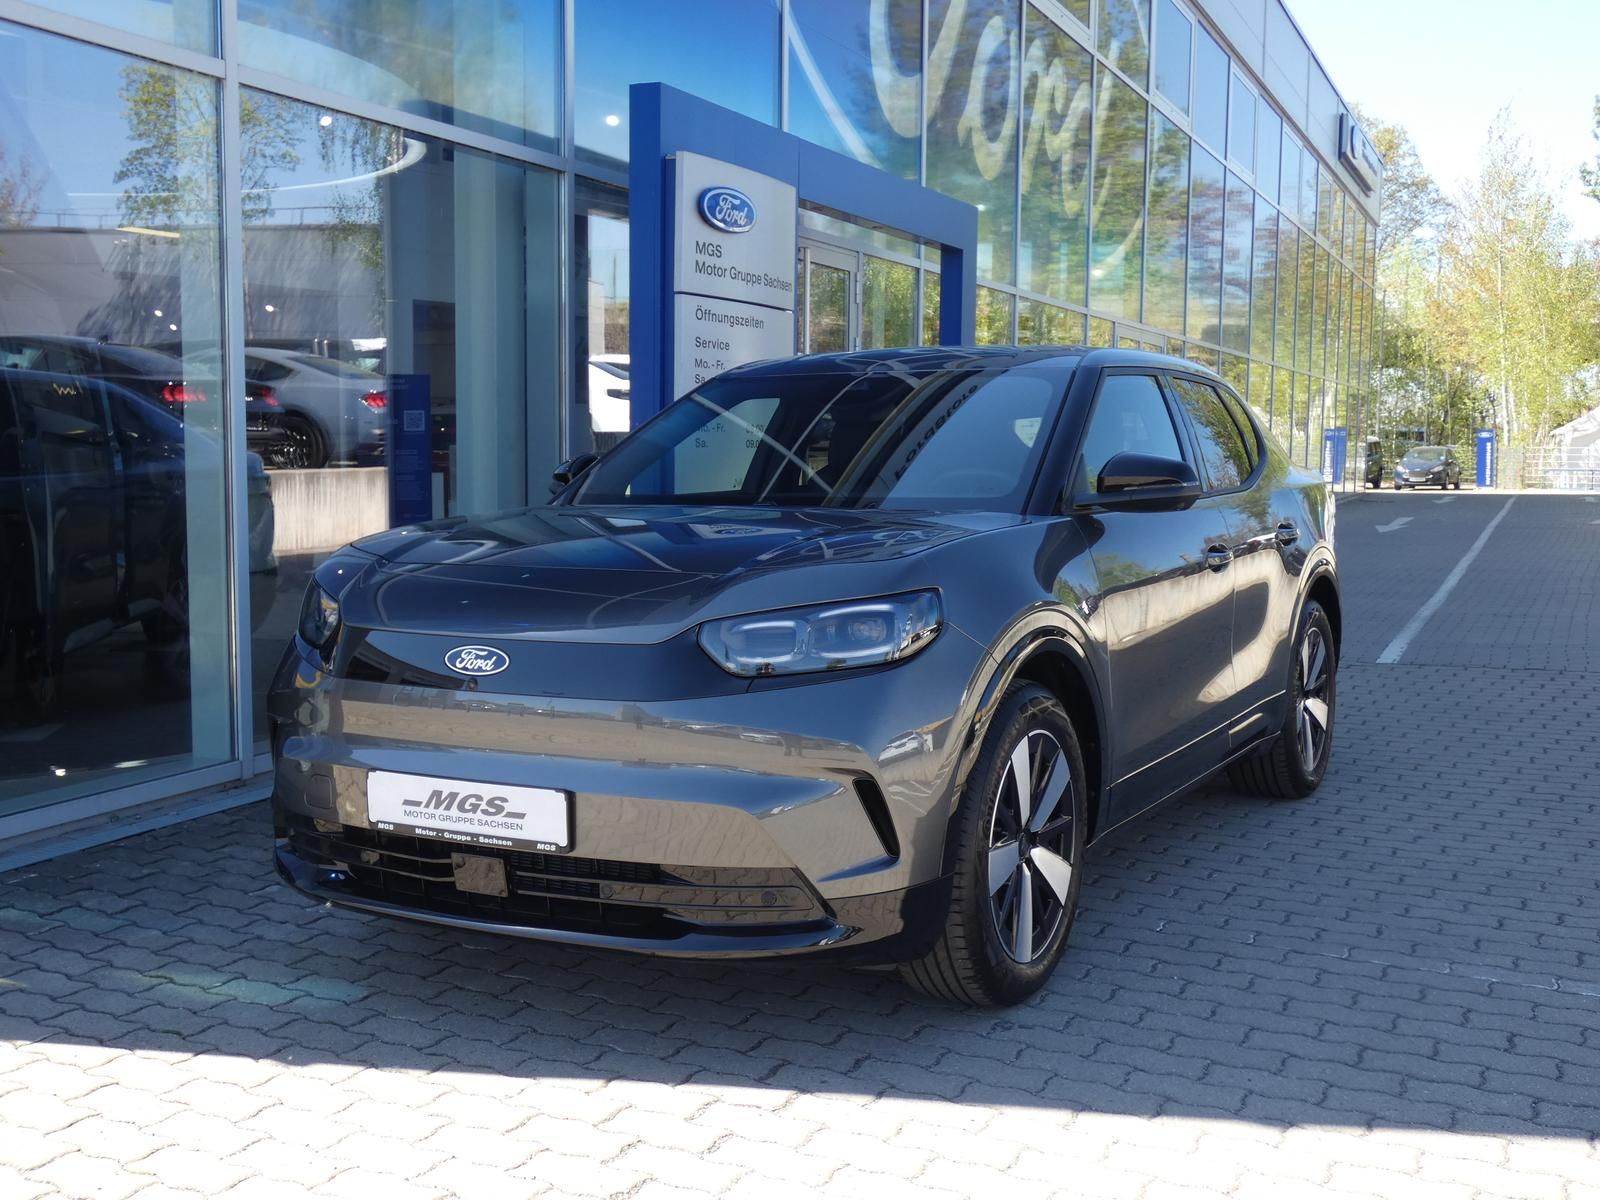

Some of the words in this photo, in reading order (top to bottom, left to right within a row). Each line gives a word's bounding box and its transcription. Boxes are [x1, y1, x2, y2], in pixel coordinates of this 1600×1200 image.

[715, 194, 748, 226] Ford
[695, 240, 722, 258] MGS
[695, 260, 727, 278] Motor
[729, 266, 762, 286] Gruppe
[763, 273, 793, 292] Sachsen
[695, 304, 764, 329] Öffnungszeiten
[695, 336, 730, 351] Service
[455, 649, 497, 671] Ford
[424, 789, 509, 817] MGS
[377, 822, 394, 831] MGS
[403, 809, 437, 821] MOTOR
[438, 813, 476, 826] GRUPPE
[477, 818, 523, 831] SACHSEN
[415, 827, 437, 837] Motor
[443, 831, 471, 842] Gruppe
[479, 836, 512, 847] Sachsen
[536, 842, 556, 852] MGS
